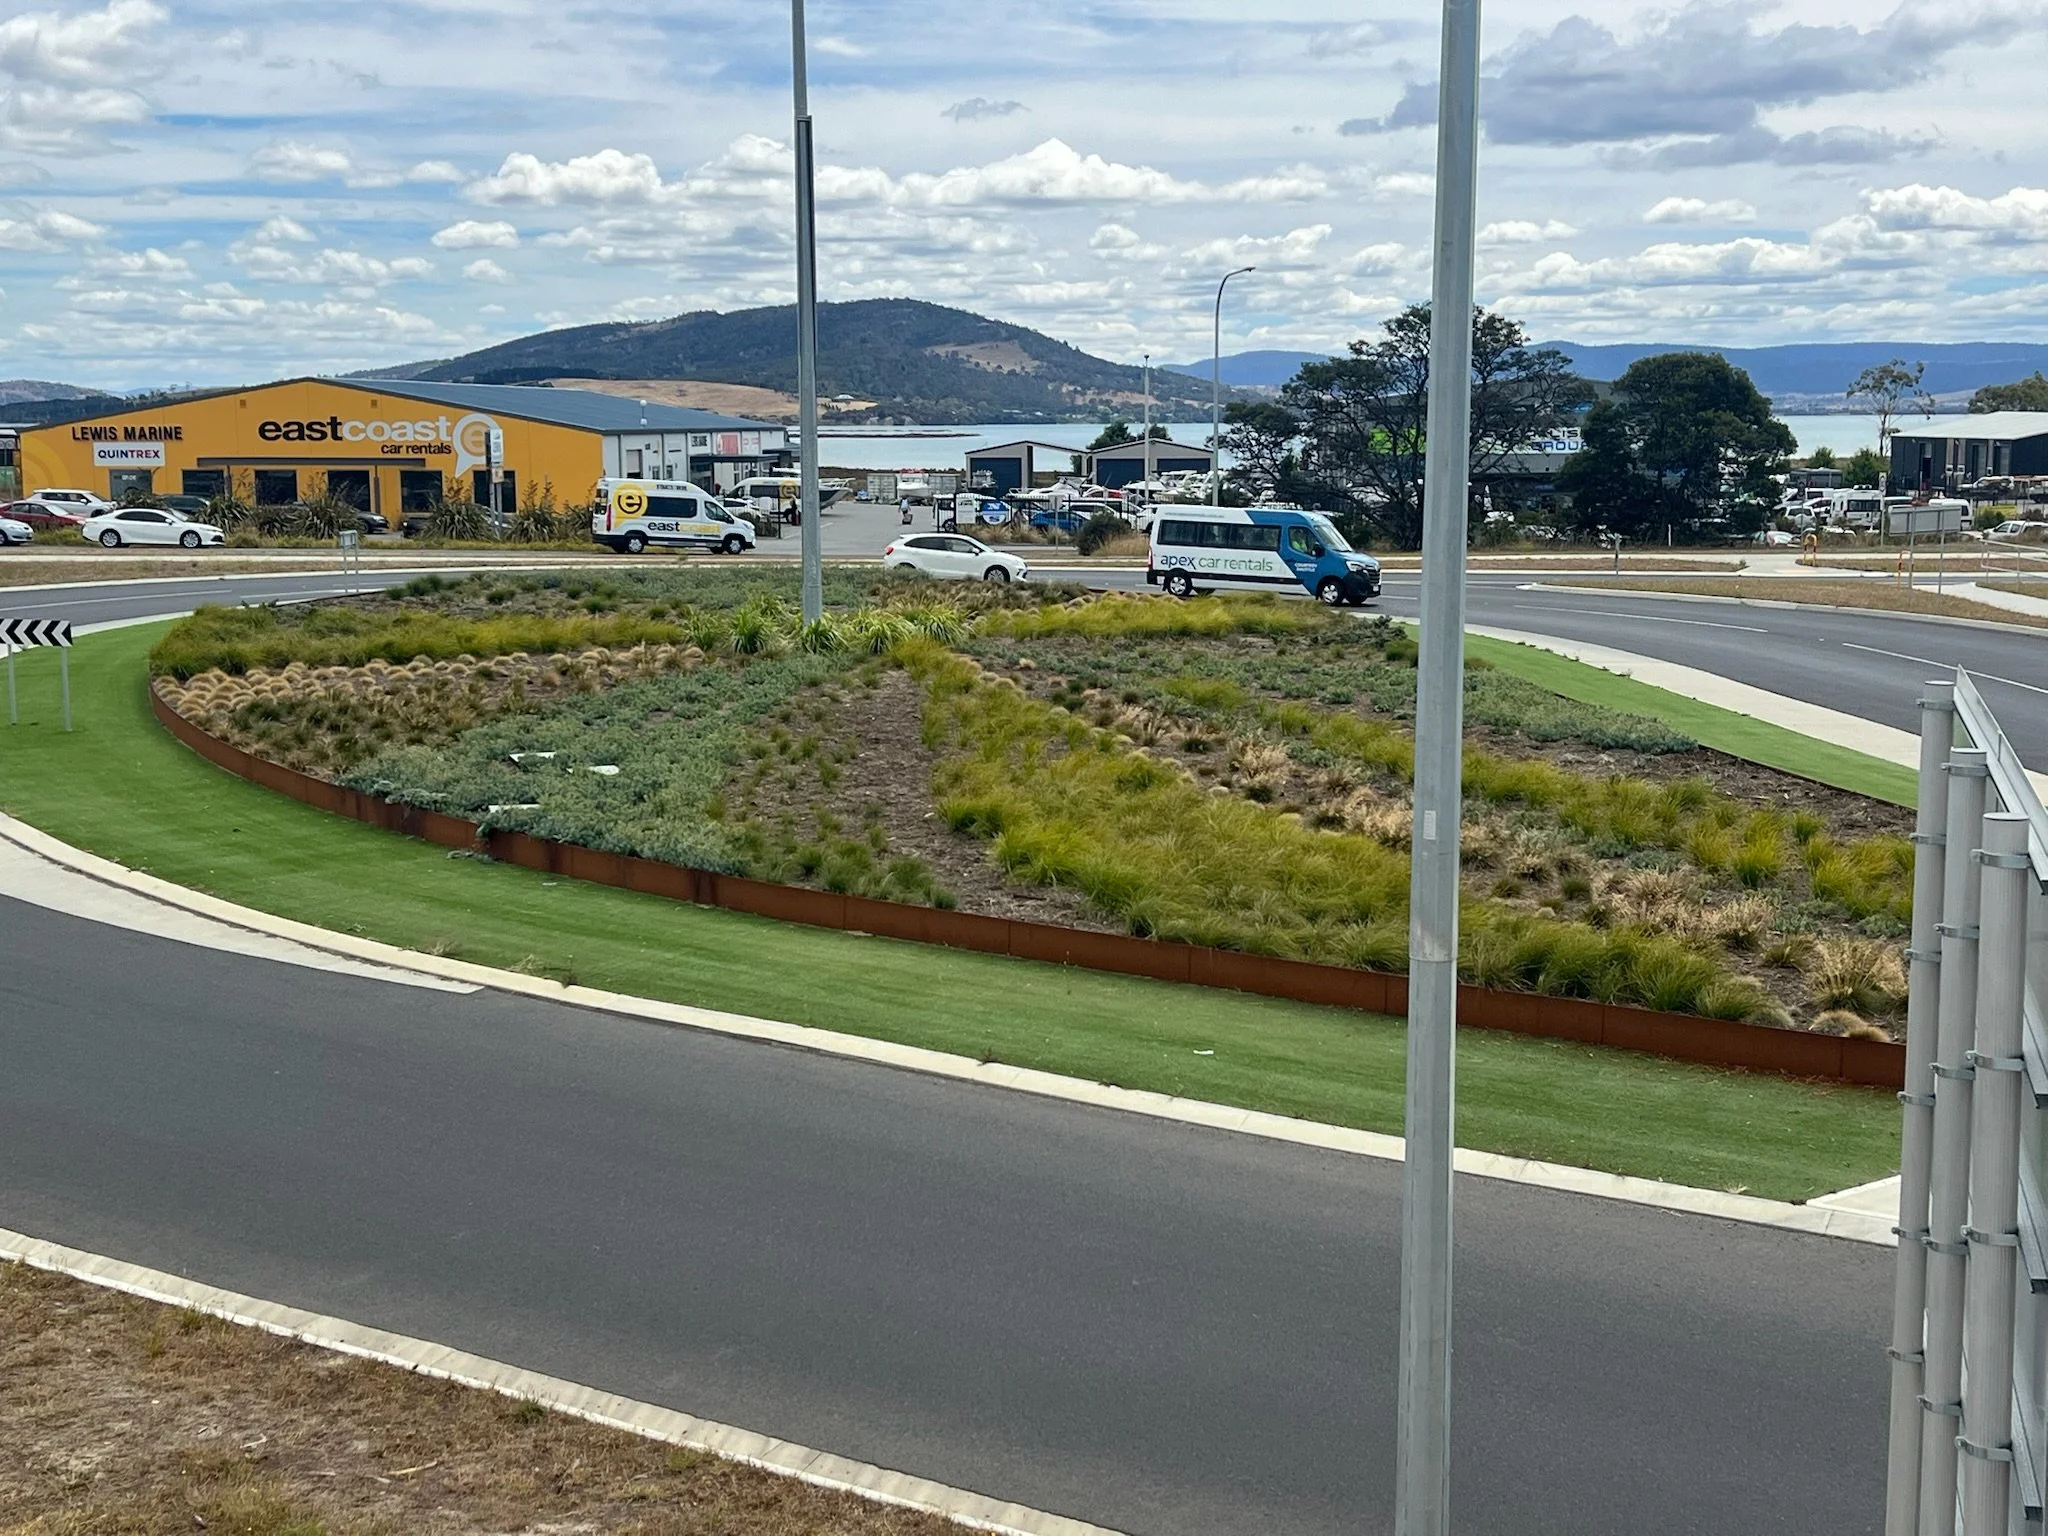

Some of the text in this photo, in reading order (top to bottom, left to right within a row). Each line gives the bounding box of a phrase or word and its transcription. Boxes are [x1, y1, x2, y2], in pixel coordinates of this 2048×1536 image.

[72, 426, 183, 441] LEWIS MARINE
[258, 416, 452, 442] eastcoast
[98, 449, 160, 459] QUINTREX
[380, 442, 452, 455] car rentals
[1160, 554, 1273, 572] apex car rentals
